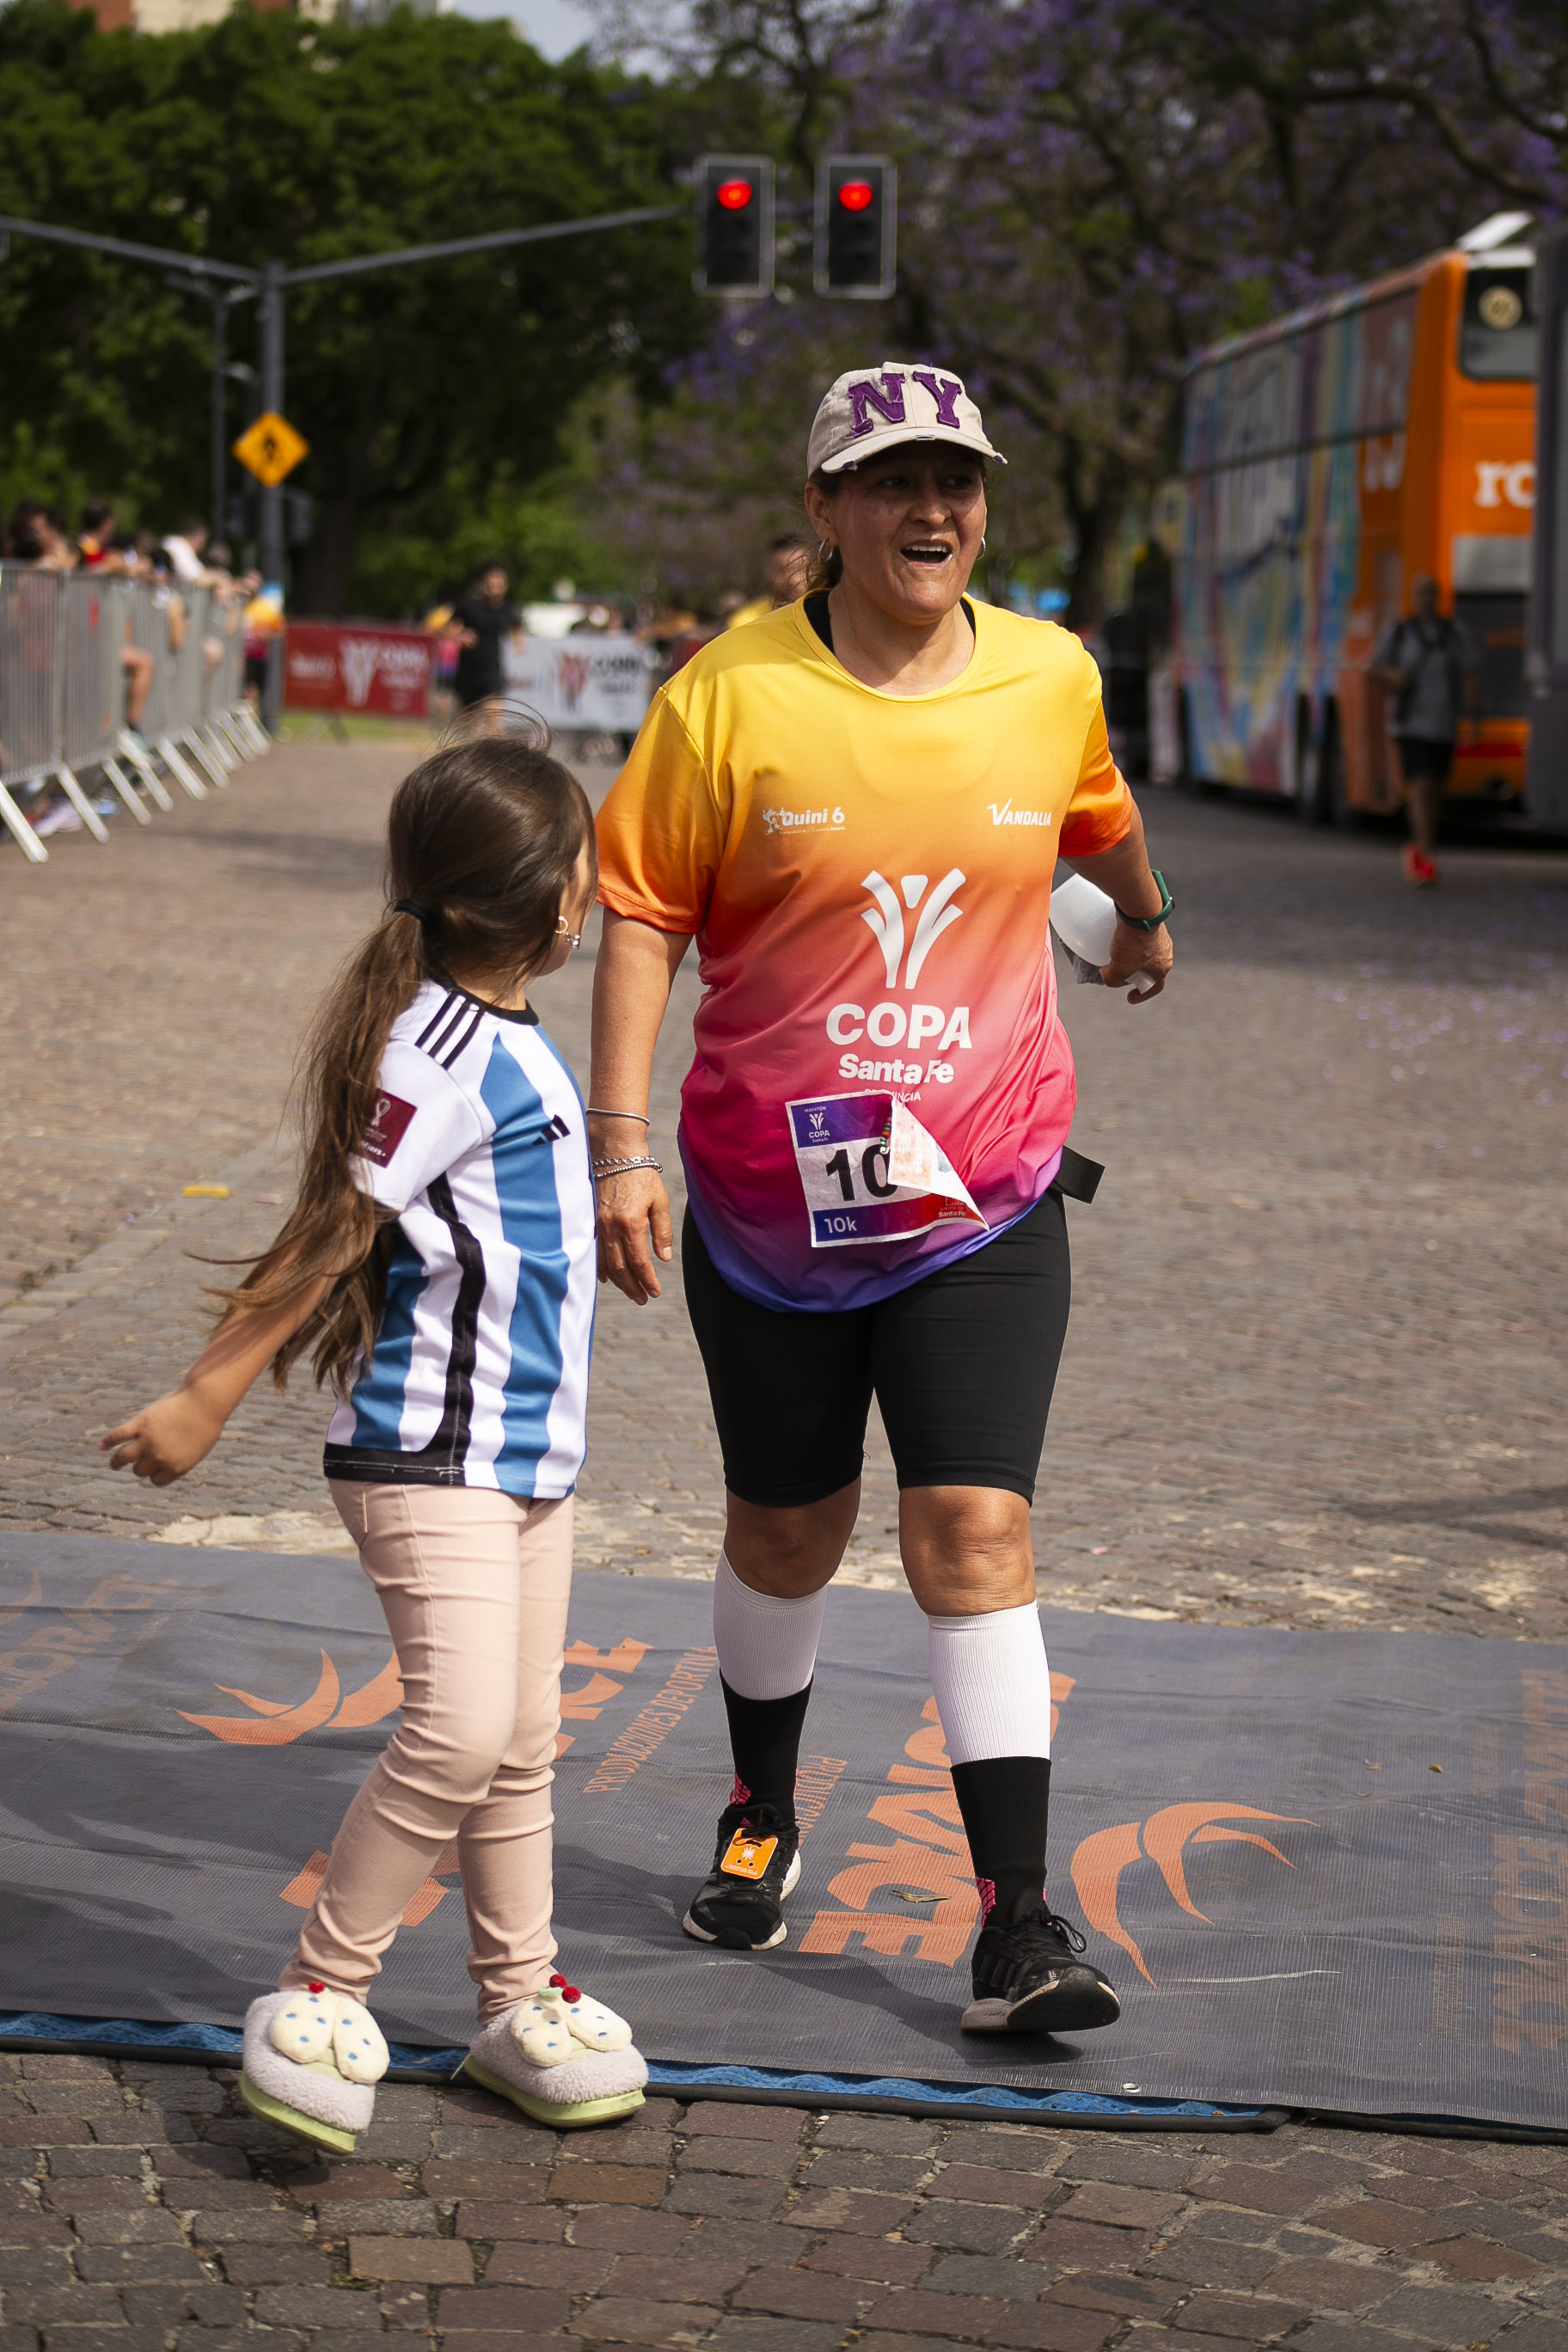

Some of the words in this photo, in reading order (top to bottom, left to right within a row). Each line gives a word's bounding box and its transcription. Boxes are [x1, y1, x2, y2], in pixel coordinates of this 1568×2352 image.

[846, 371, 962, 438] NY
[782, 808, 828, 826] Quini
[832, 806, 845, 824] 6
[987, 798, 1051, 826] VANDALIA
[826, 1002, 972, 1050] COPA
[839, 1054, 922, 1084] Santa
[924, 1060, 954, 1083] Fe
[824, 1216, 857, 1234] 10k
[582, 1707, 682, 1795] PRODUCCIONES
